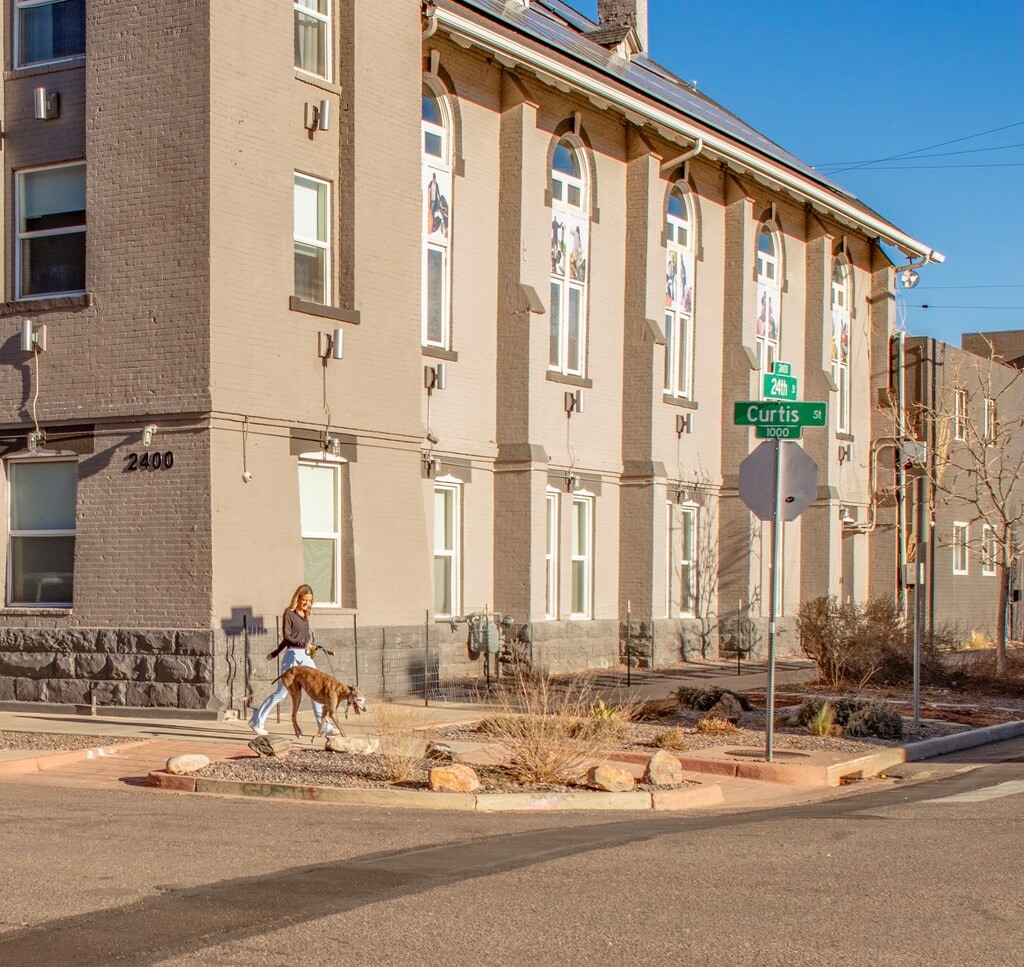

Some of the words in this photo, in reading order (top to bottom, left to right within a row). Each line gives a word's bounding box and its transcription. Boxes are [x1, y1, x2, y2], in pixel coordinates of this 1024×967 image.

[771, 378, 788, 396] 24th
[747, 406, 800, 423] Curtis
[812, 410, 822, 420] St
[767, 428, 790, 437] 1000
[128, 451, 174, 470] 2400
